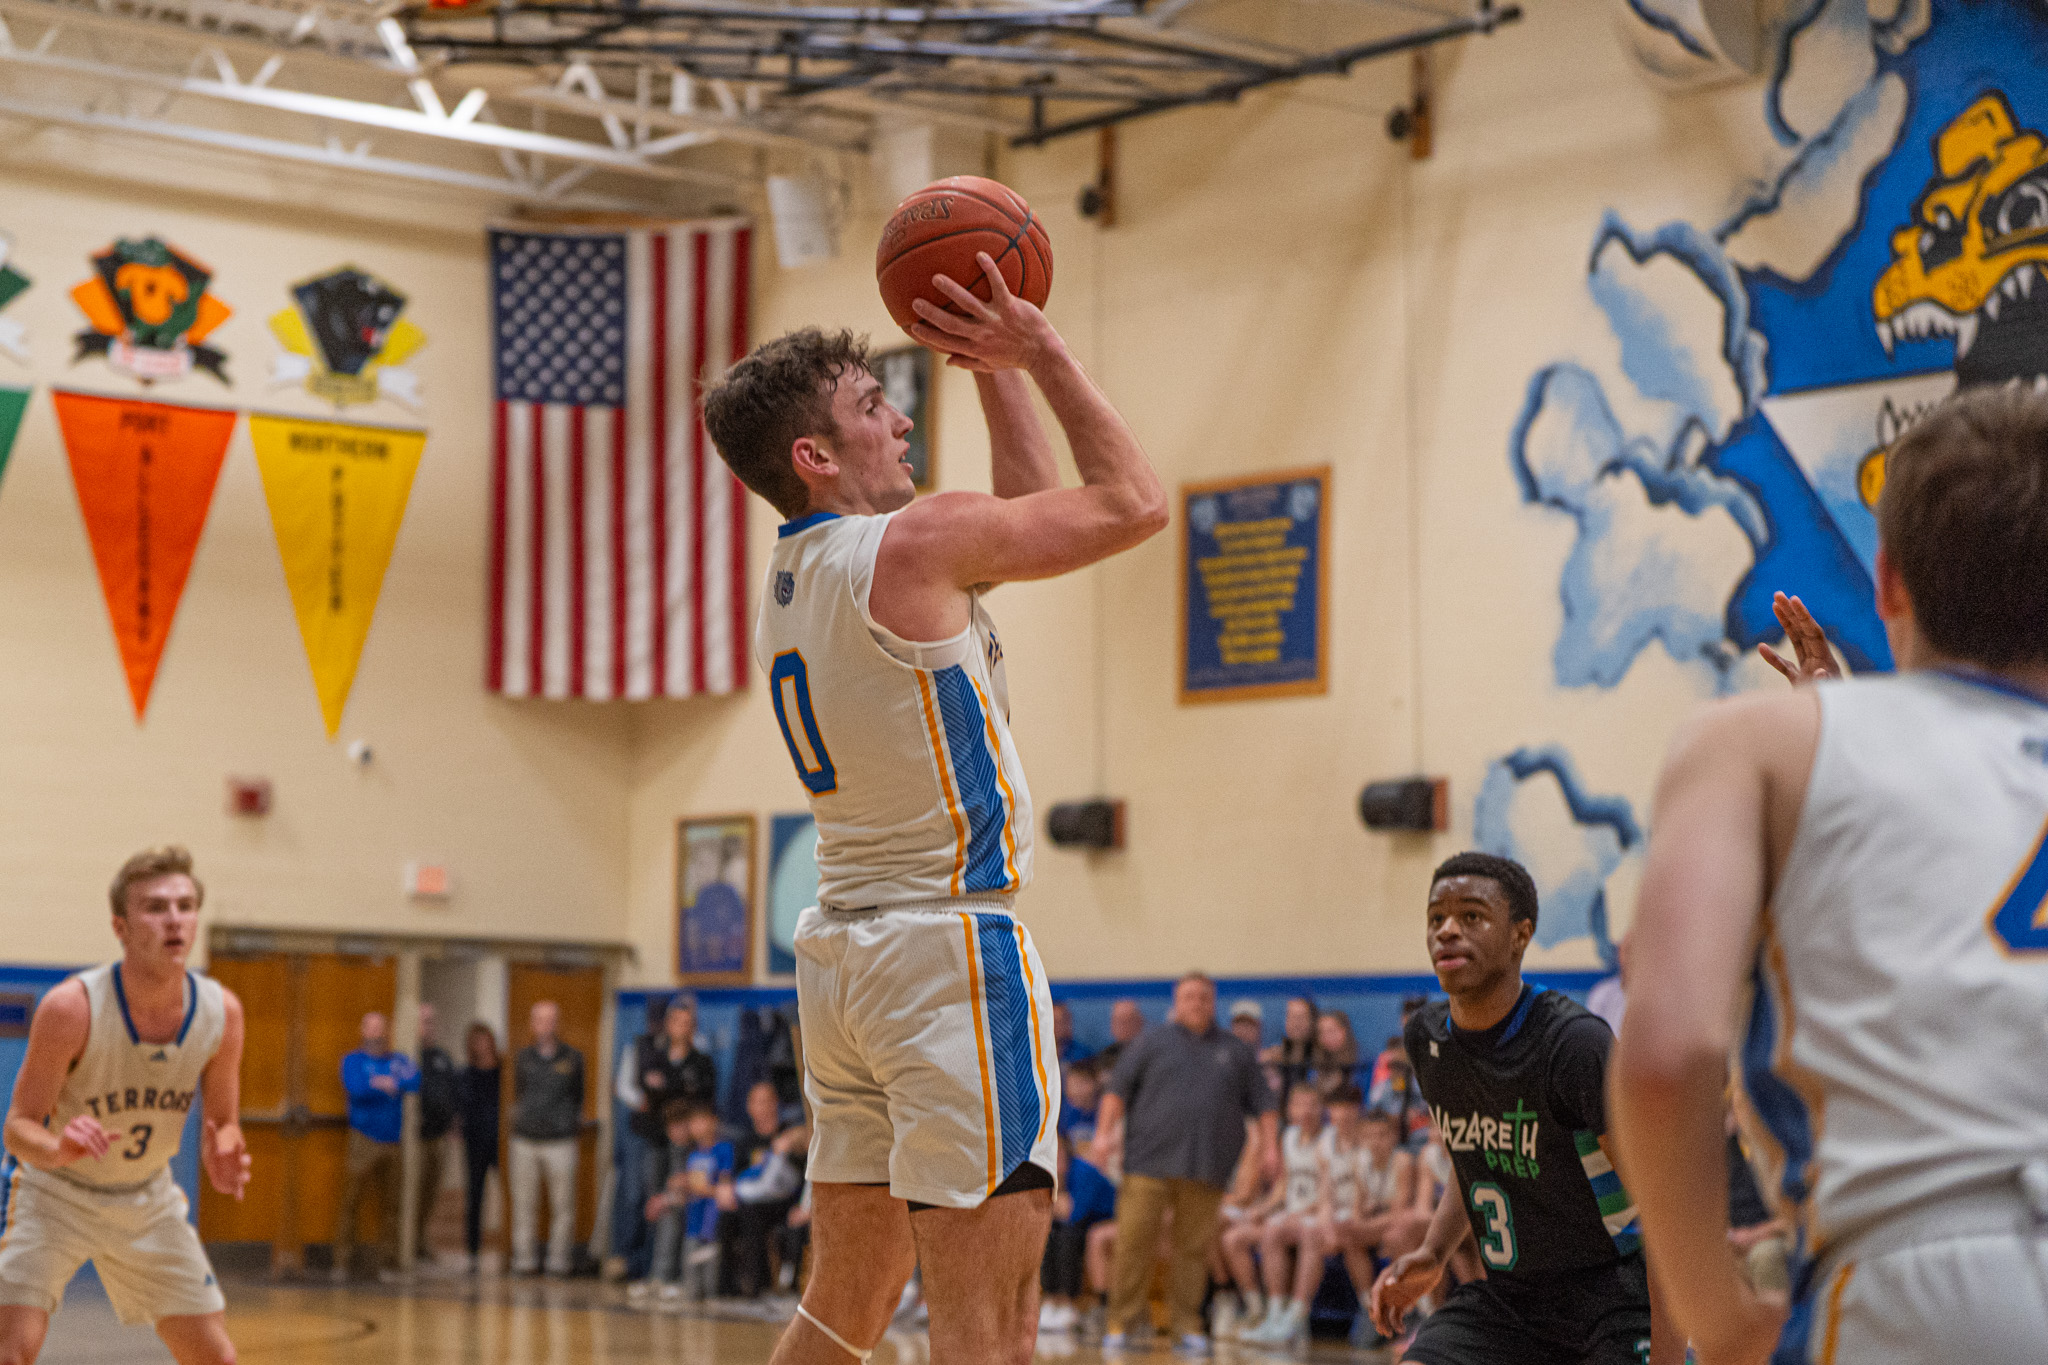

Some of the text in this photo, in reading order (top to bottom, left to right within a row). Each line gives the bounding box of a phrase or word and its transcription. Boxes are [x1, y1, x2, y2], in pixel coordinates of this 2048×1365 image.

[770, 647, 838, 798] 0
[123, 1123, 153, 1160] 3
[1485, 1150, 1540, 1179] PREP
[1470, 1181, 1519, 1271] 3
